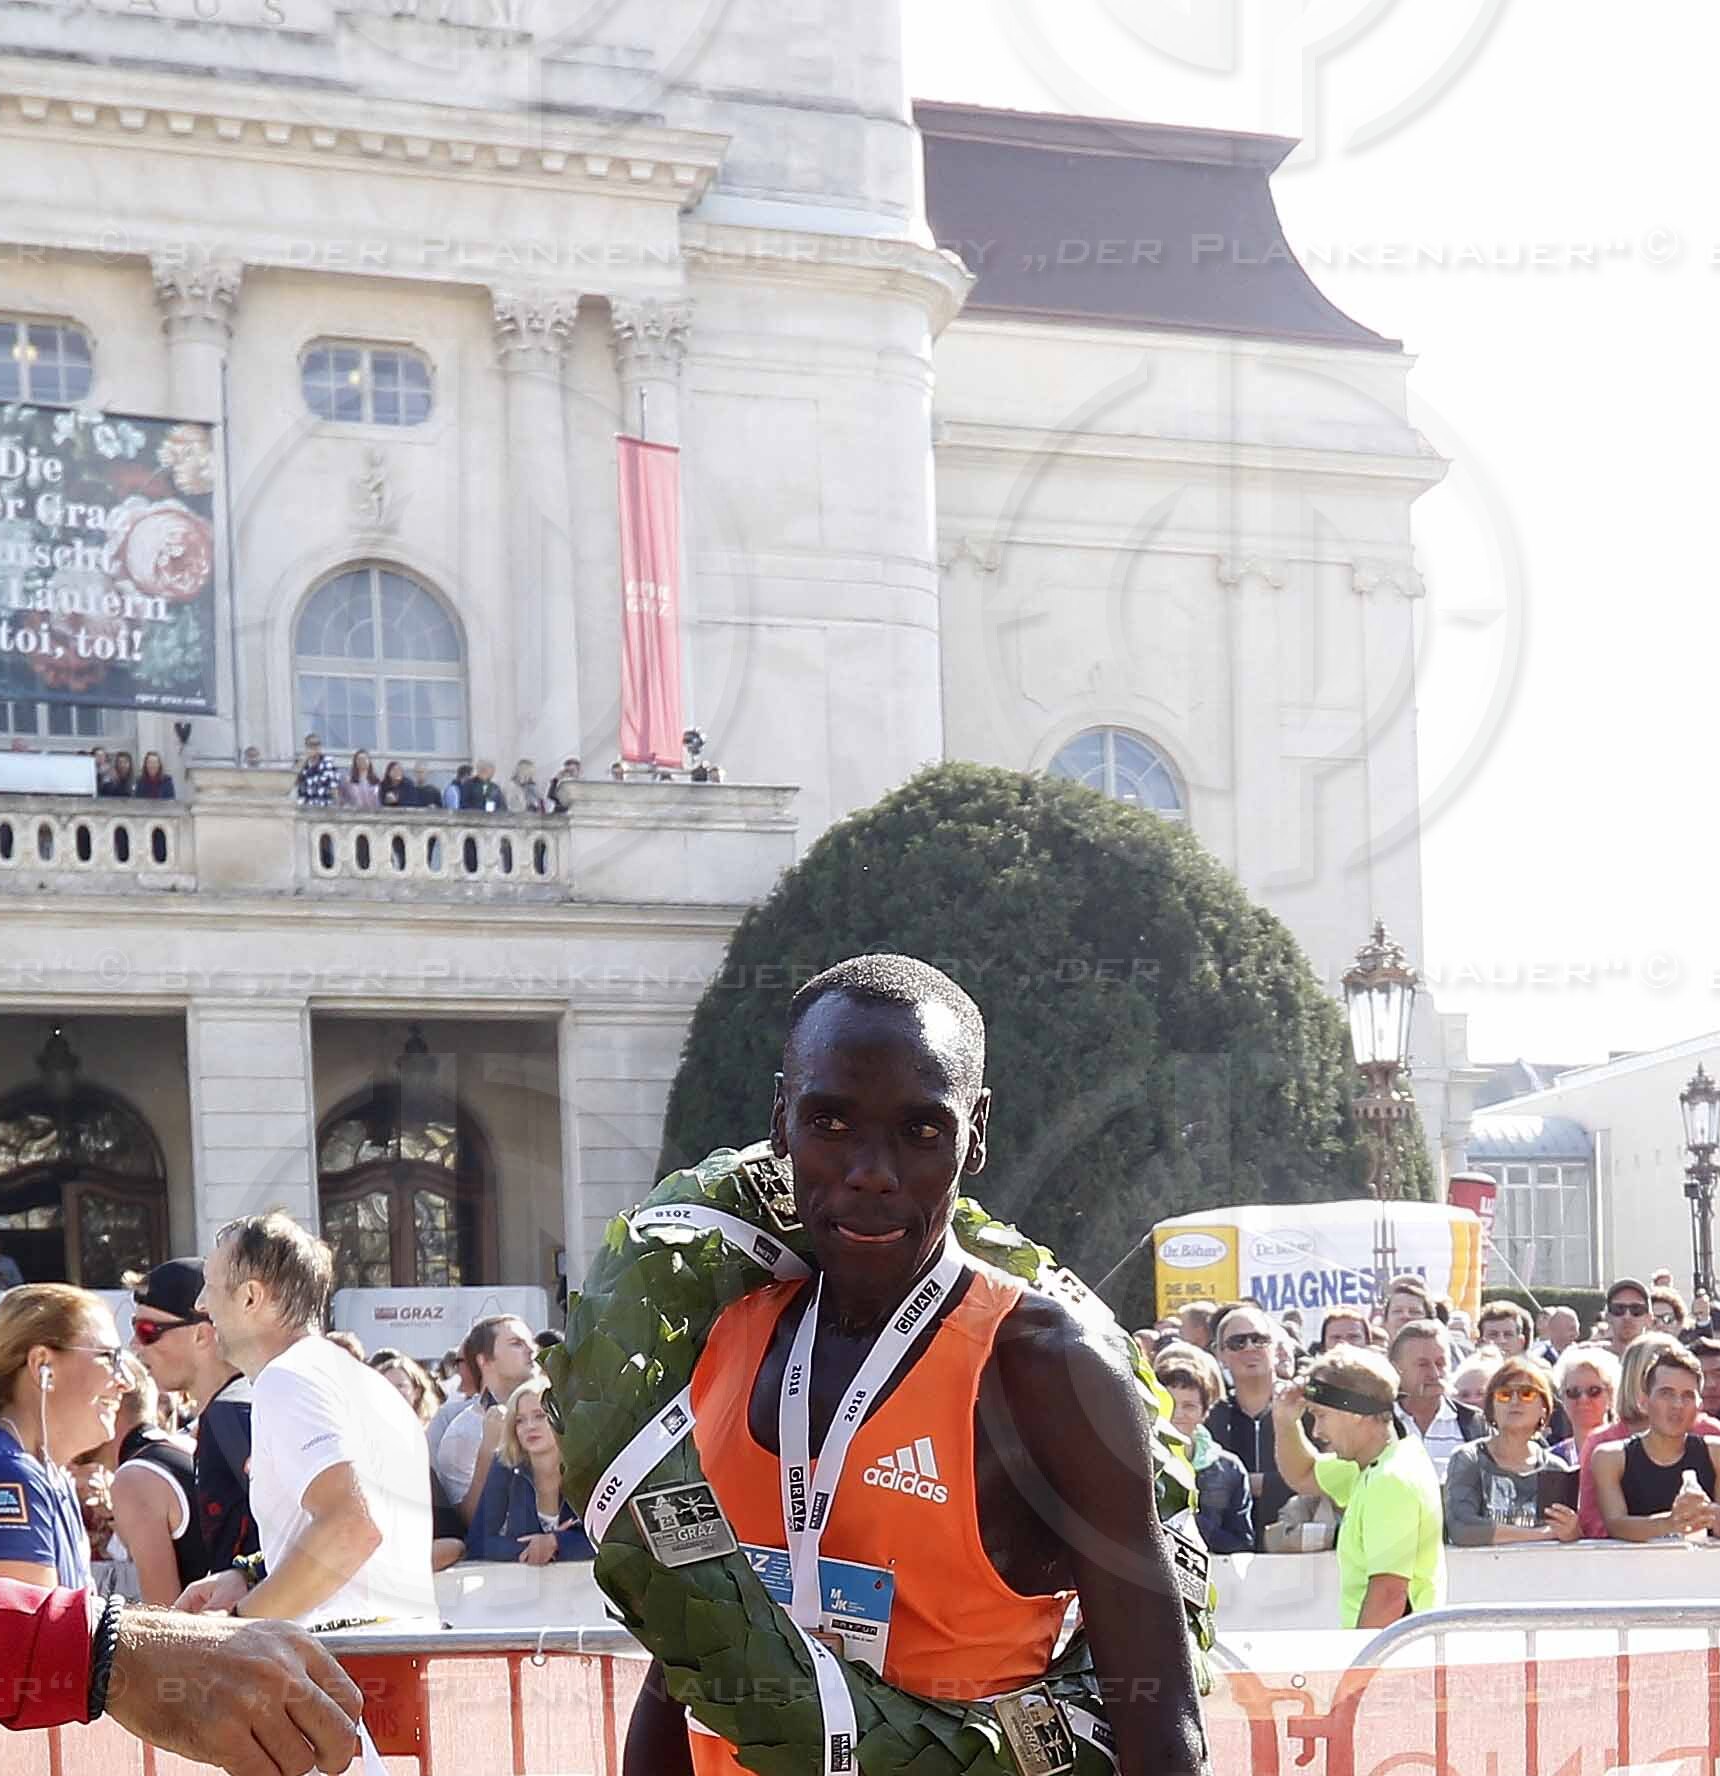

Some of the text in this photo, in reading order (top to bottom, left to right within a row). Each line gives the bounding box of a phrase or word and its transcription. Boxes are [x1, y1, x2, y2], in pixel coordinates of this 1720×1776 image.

[76, 625, 143, 662] toi!
[399, 1306, 443, 1320] GRAZ
[894, 1280, 944, 1336] GRAZ
[787, 1364, 803, 1398] 2018
[844, 1389, 868, 1424] 2018
[595, 1475, 624, 1513] 2018
[789, 1466, 806, 1533] GRAZ
[863, 1465, 949, 1505] adidas
[677, 1524, 718, 1543] GRAZ
